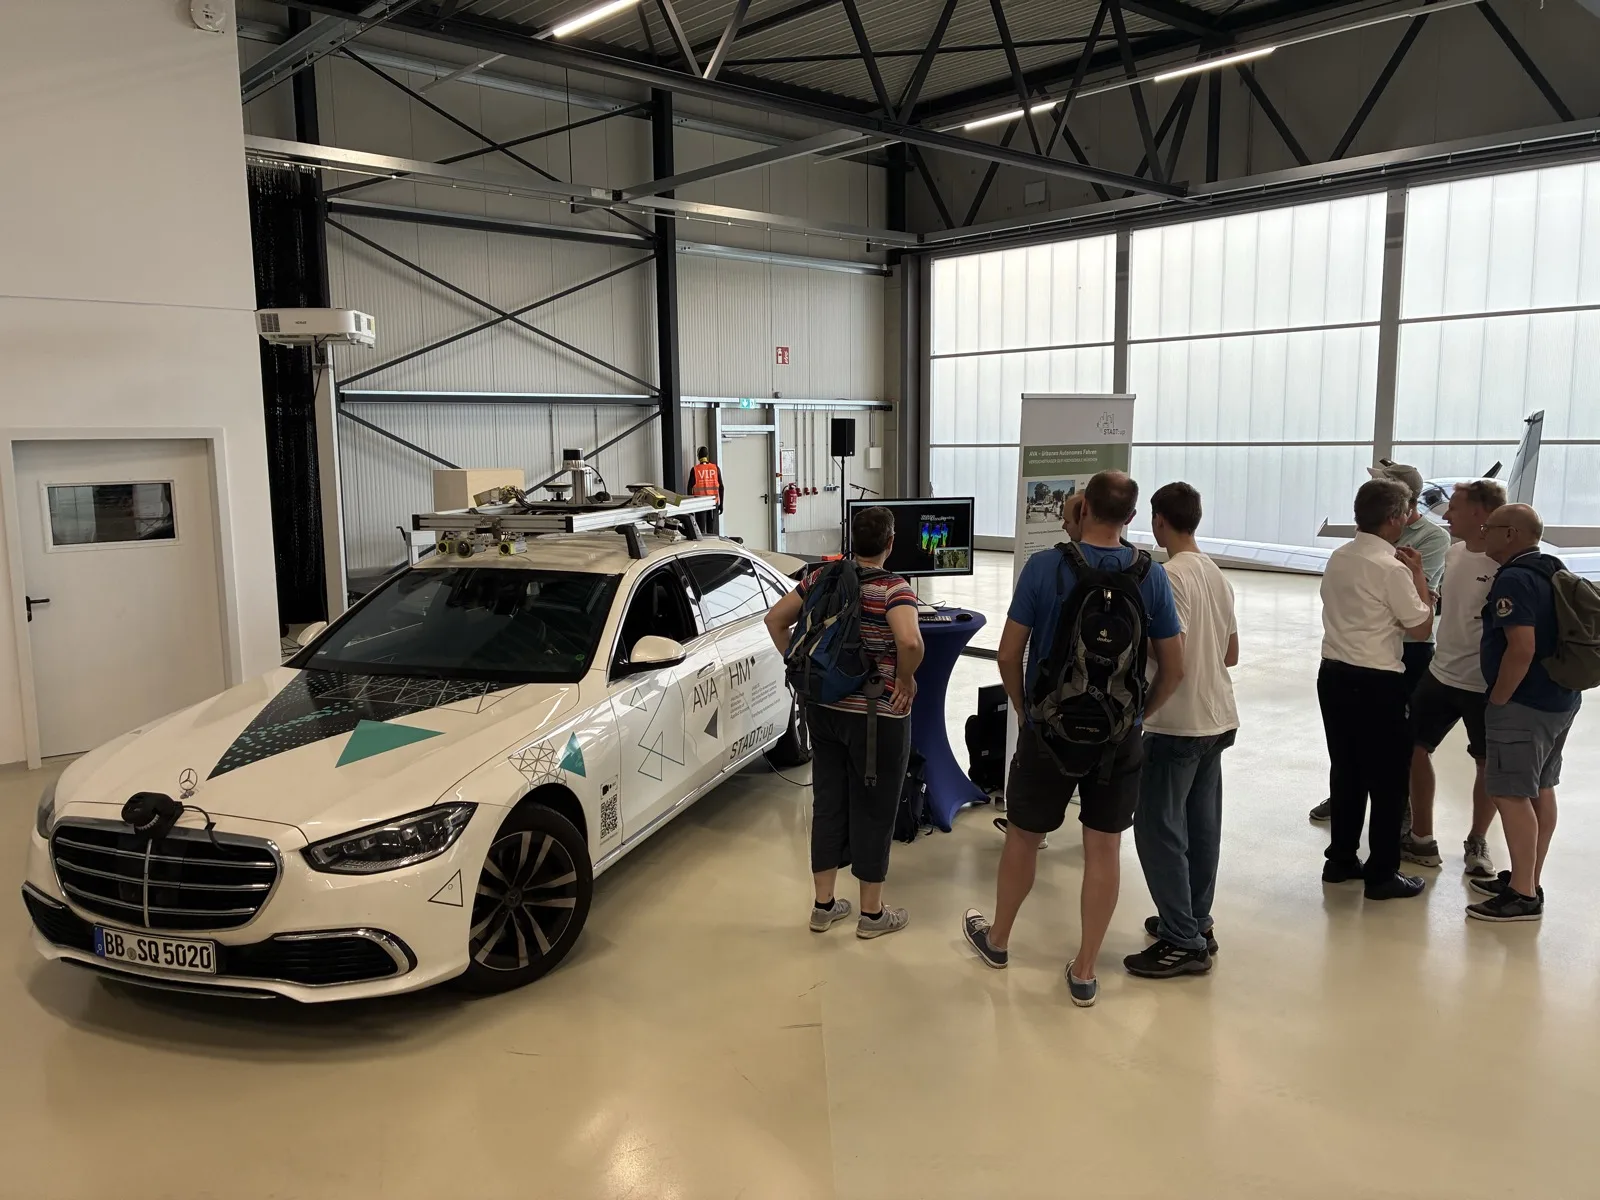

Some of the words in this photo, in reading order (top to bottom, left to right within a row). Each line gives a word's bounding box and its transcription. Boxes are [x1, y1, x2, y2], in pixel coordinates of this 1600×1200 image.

[698, 469, 716, 479] VIP
[728, 658, 751, 689] HM
[693, 676, 719, 713] AVA
[729, 722, 774, 760] STADT:up
[104, 931, 125, 957] BB
[137, 938, 160, 963] SQ
[162, 942, 212, 969] 5020
